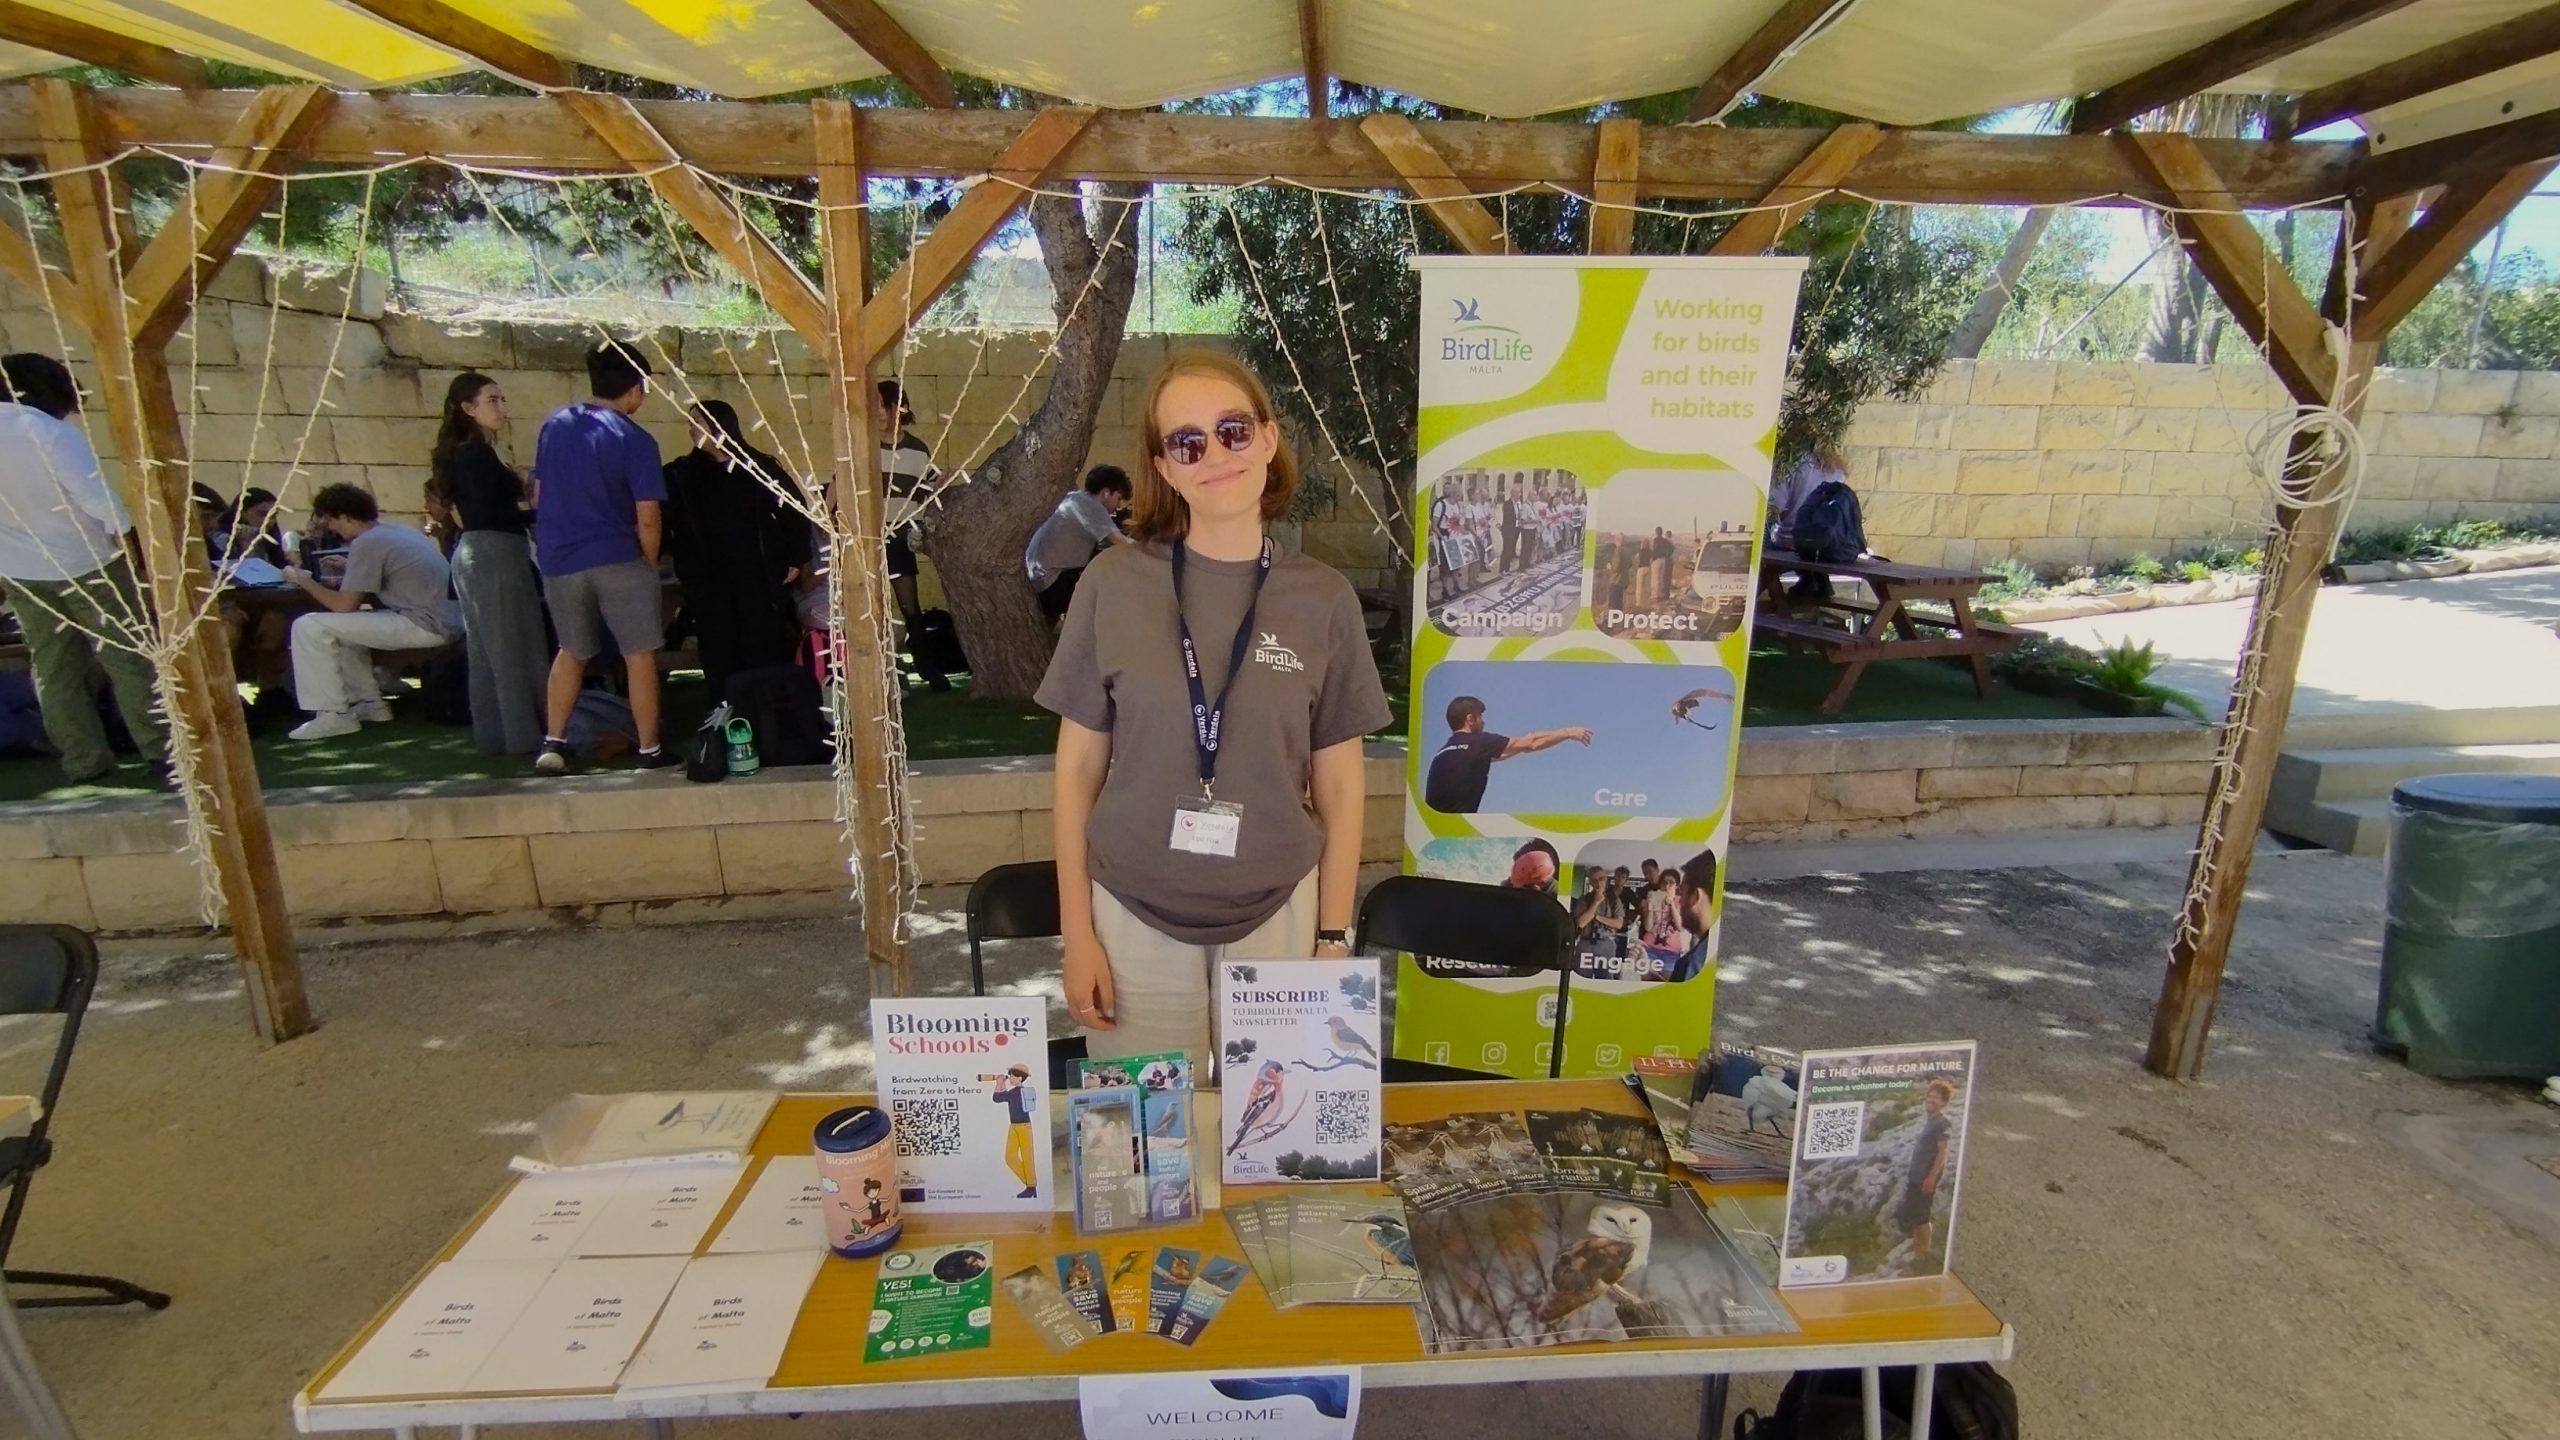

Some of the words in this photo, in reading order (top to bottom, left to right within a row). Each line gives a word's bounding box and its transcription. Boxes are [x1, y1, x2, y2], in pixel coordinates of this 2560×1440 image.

[1653, 299, 1764, 323] Working
[1653, 331, 1687, 353] for
[1697, 331, 1761, 354] birds
[1441, 337, 1533, 362] BirdLife
[1469, 366, 1503, 374] MALTA
[1641, 365, 1689, 386] and
[1699, 364, 1757, 386] their
[1650, 397, 1754, 419] habitats
[1441, 607, 1563, 632] Campaign
[1607, 609, 1698, 631] Protect
[1255, 649, 1304, 671] BirdLife
[1272, 664, 1292, 673] MALTA
[1594, 788, 1648, 807] Care
[1579, 952, 1665, 975] Engage
[1232, 989, 1330, 1004] SUBSCRIBE
[1232, 1008, 1246, 1016] TO
[1247, 1007, 1295, 1016] BIRDLIFE
[1295, 1007, 1329, 1015] MALTA
[887, 1012, 1030, 1037] Blooming
[1232, 1018, 1297, 1026] NEWSLETTER
[888, 1035, 990, 1055] Schools
[1720, 1041, 1768, 1061] Bird's
[1771, 1055, 1801, 1067] Eye
[1812, 1069, 1826, 1079] BE
[1829, 1068, 1849, 1078] THE
[1851, 1065, 1895, 1077] CHANGE
[1897, 1063, 1917, 1073] FOR
[891, 1075, 959, 1084] Birdwatching
[892, 1087, 917, 1096] from
[919, 1087, 943, 1095] Zero
[946, 1087, 956, 1095] to
[958, 1086, 982, 1094] Hero
[1812, 1084, 1844, 1094] Become
[1852, 1081, 1888, 1091] volunteer
[1889, 1079, 1913, 1090] today!
[826, 1148, 879, 1166] Blooming
[1089, 1170, 1117, 1179] nature
[1233, 1164, 1270, 1175] BirdLife
[1560, 1174, 1600, 1182] nature
[672, 1185, 697, 1193] Birds
[1089, 1183, 1117, 1194] people
[1630, 1188, 1655, 1198] ture
[668, 1196, 698, 1204] Malta
[1297, 1203, 1347, 1212] discovering
[1297, 1210, 1328, 1218] nature
[883, 1279, 912, 1290] YES!
[592, 1297, 622, 1306] Birds
[713, 1297, 743, 1306] Birds
[1073, 1293, 1098, 1302] save
[1111, 1297, 1143, 1306] people
[1189, 1294, 1213, 1306] save
[444, 1303, 475, 1311] Birds
[1035, 1302, 1063, 1318] nature
[1075, 1303, 1101, 1312] nature
[1724, 1307, 1768, 1317] BirdLife
[587, 1311, 622, 1319] Malta
[711, 1310, 745, 1319] Malta
[1041, 1310, 1071, 1328] people
[437, 1317, 472, 1326] Malta
[1147, 1407, 1284, 1425] WELCOME
